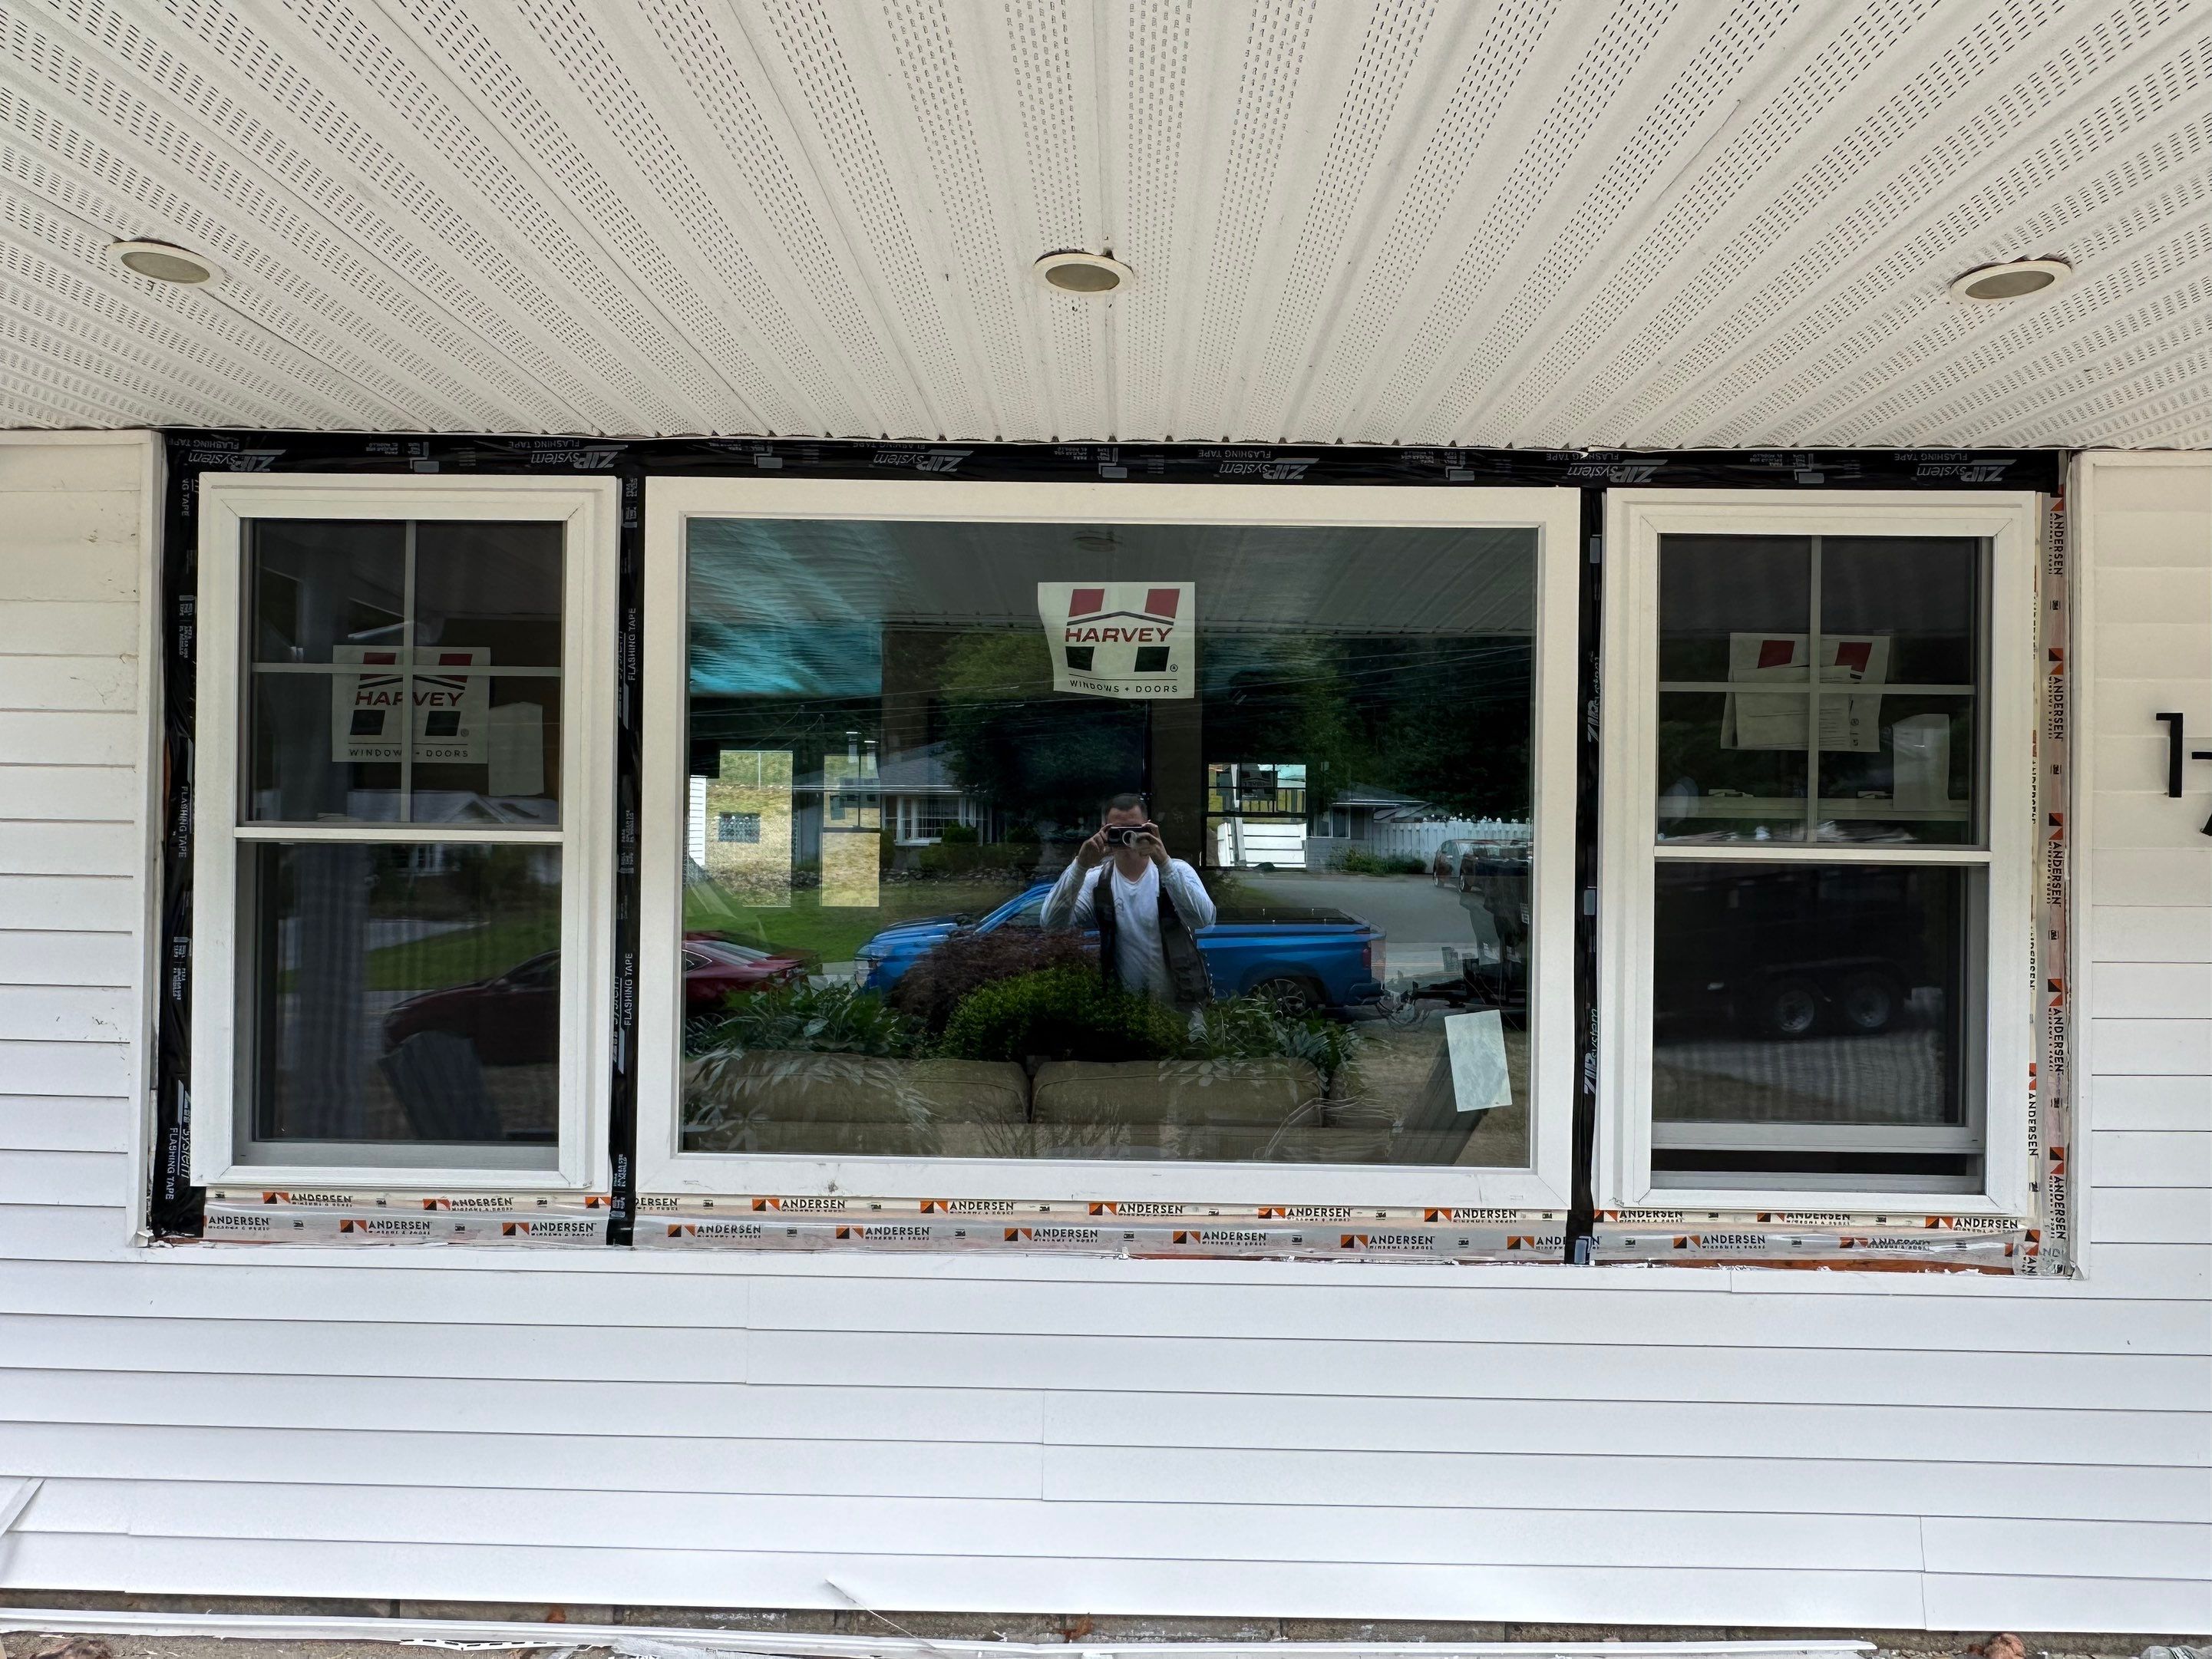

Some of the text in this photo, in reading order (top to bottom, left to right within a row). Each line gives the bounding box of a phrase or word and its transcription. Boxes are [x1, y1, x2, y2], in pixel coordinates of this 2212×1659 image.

[193, 439, 240, 449] FLASHING
[531, 450, 619, 469] ZIP system
[1198, 450, 1271, 459] FLASHING TAPE
[1546, 452, 1619, 461] FLASHG TAPE
[1893, 453, 1968, 461] FLASHING TAPE
[873, 454, 964, 472] ZIP system
[1220, 463, 1308, 480] ZIP system
[1567, 465, 1658, 483] ZIP system
[1917, 465, 2004, 482] ZIP system
[2053, 513, 2065, 576] ANDERSEN
[1065, 628, 1174, 642] HARVEY
[627, 607, 636, 681] FLASHING TAPE
[1070, 680, 1120, 693] WINDOWS
[2052, 676, 2065, 741] ANDERSEN
[348, 748, 408, 757] WINDOW
[2156, 713, 2184, 798] 1
[178, 834, 187, 859] TAPE
[2052, 842, 2063, 906] ANDERSEN
[623, 952, 633, 1026] FLASHING TAPE
[2053, 1008, 2065, 1074] ANDERSEN
[2028, 1092, 2039, 1157] ANDERSEN
[165, 1127, 179, 1200] FLASHING TAPE
[451, 1197, 513, 1207] ANDERSEN
[781, 1199, 847, 1209] ANDERSEN
[949, 1201, 1015, 1211] ANDERSEN
[2053, 1175, 2066, 1240] ANDERSEN
[1118, 1203, 1184, 1214] ANDERSEN
[1286, 1207, 1352, 1217] ANDERSEN
[1453, 1209, 1517, 1219] ANDERSEN
[208, 1215, 270, 1226] ANDERSEN
[368, 1220, 431, 1230] ANDERSEN
[1954, 1217, 2019, 1229] ANDERSEN
[530, 1222, 595, 1232] ANDERSEN
[697, 1224, 761, 1235] ANDERSEN
[865, 1226, 930, 1235] ANDERSEN
[1034, 1229, 1098, 1238] ANDERSEN
[1202, 1231, 1266, 1242] ANDERSEN
[1369, 1235, 1434, 1245] ANDERSEN
[1702, 1235, 1766, 1244] ANDERSEN
